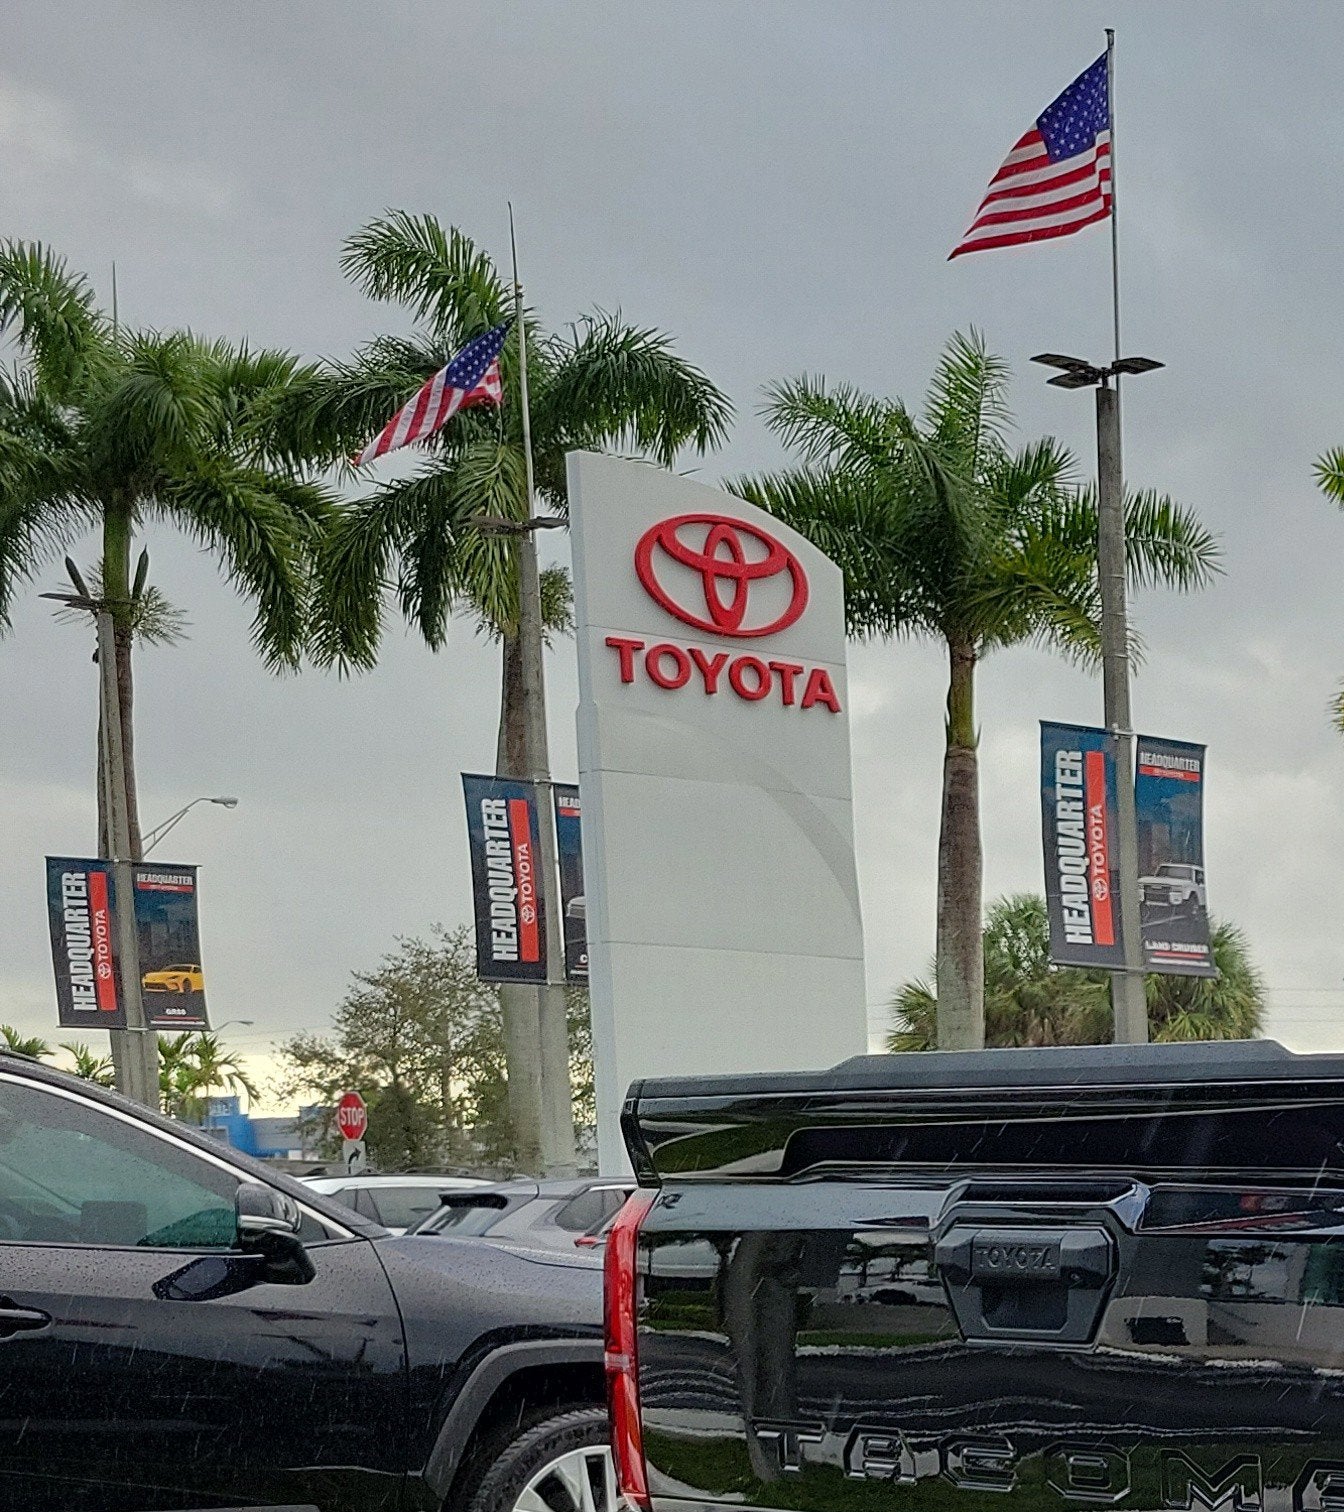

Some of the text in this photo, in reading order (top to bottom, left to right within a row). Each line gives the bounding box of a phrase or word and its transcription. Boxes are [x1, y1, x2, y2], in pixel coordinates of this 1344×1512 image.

[605, 636, 842, 713] TOYOTA
[518, 843, 533, 903] TOYOTA
[1056, 750, 1093, 944] HEADQUARTER
[1088, 804, 1107, 875] TOYOTA
[481, 798, 518, 961] HEADQUARTER
[62, 872, 97, 1011] HEADQUARTER
[95, 909, 110, 961] TOYOTA
[340, 1108, 364, 1126] STOP
[973, 1246, 1056, 1270] TOYOTA
